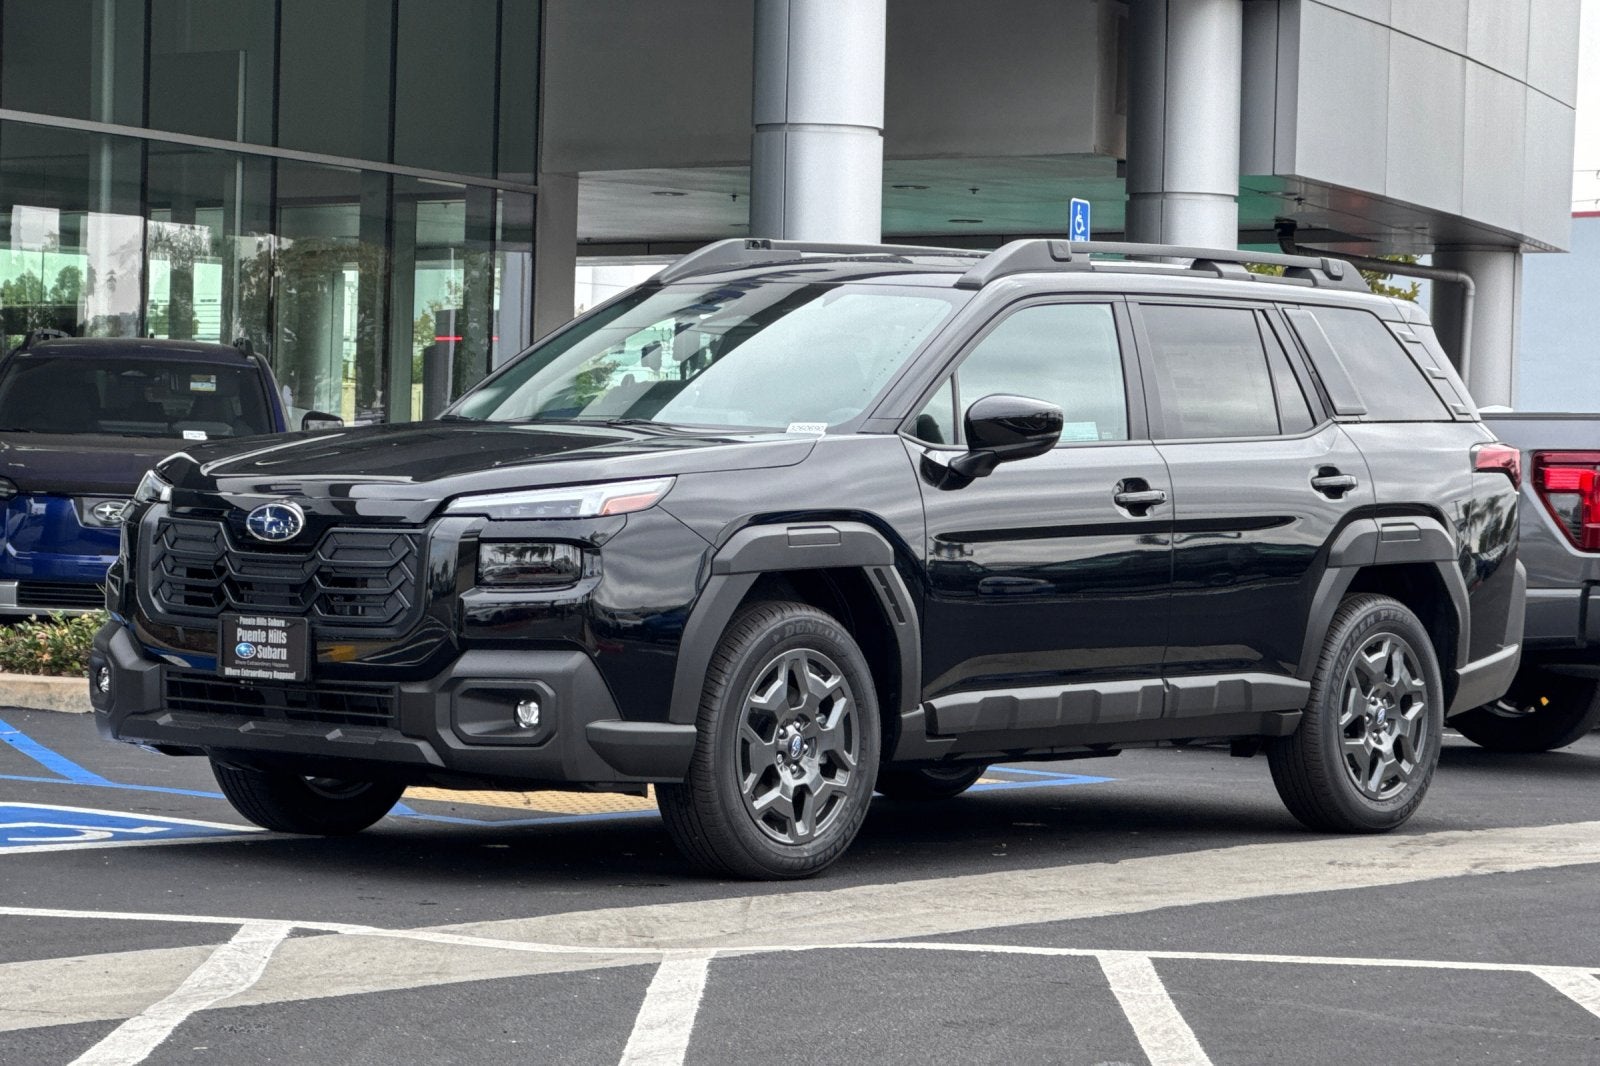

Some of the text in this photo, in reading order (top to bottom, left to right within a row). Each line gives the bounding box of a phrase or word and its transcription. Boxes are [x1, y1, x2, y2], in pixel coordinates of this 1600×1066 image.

[236, 627, 287, 644] Puente Hills
[257, 644, 287, 660] Subaru
